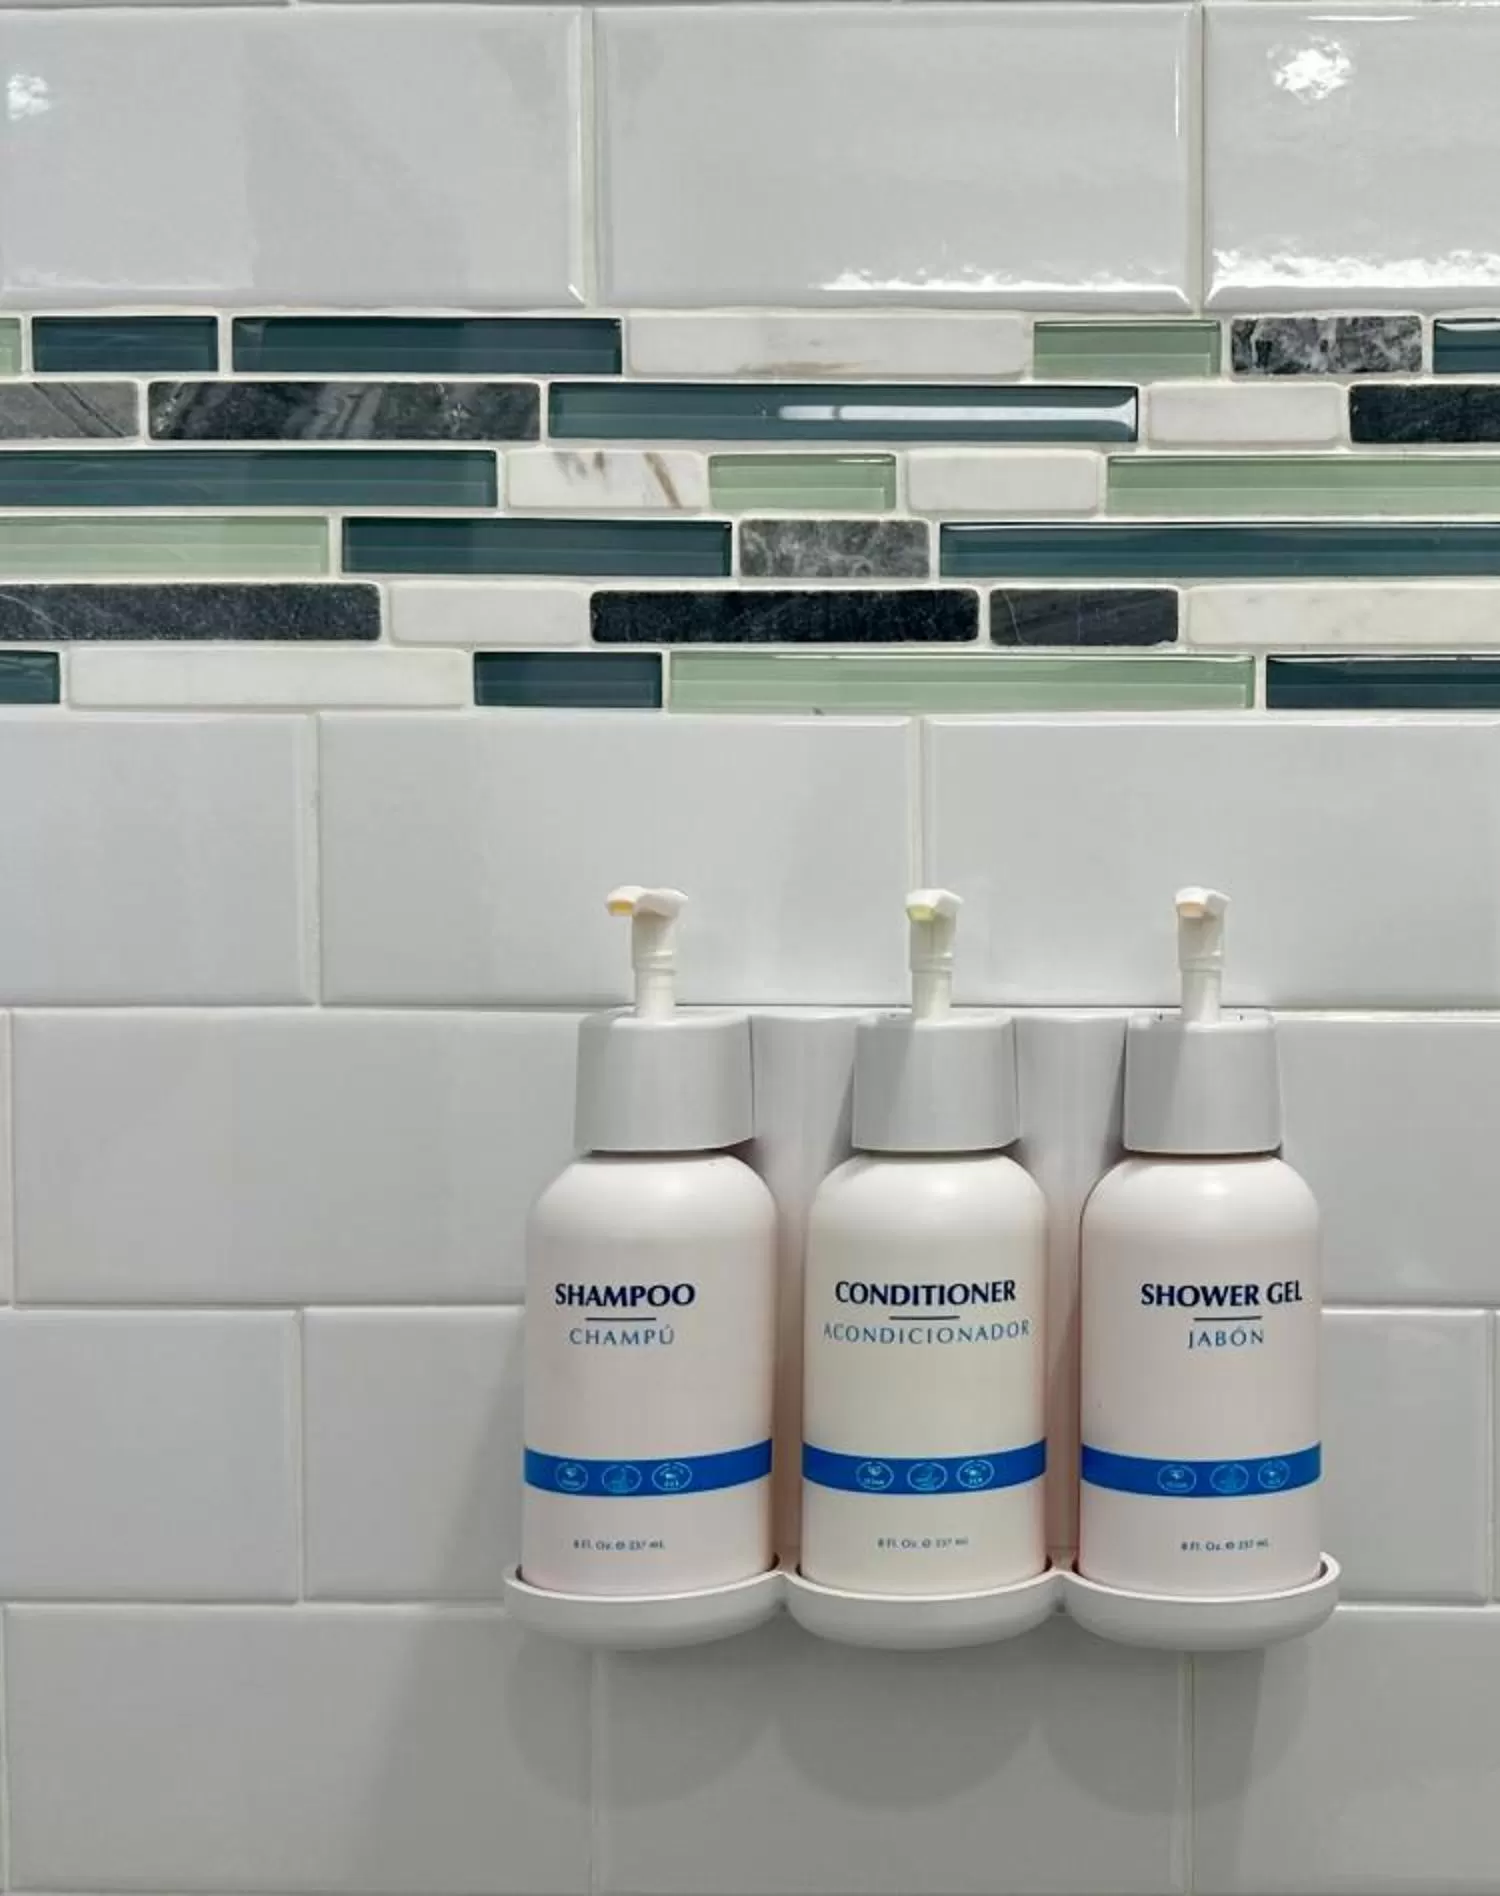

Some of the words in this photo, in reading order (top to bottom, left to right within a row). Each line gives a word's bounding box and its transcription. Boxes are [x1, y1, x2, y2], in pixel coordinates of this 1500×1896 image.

[554, 1282, 696, 1308] SHAMPOO
[834, 1279, 1016, 1307] CONDITIONER
[1140, 1283, 1260, 1307] SHOWER
[1266, 1280, 1303, 1305] GEL
[568, 1324, 676, 1346] CHAMPÚ
[822, 1319, 1031, 1345] ACONDICIONADOR
[1187, 1326, 1265, 1349] JABÓN
